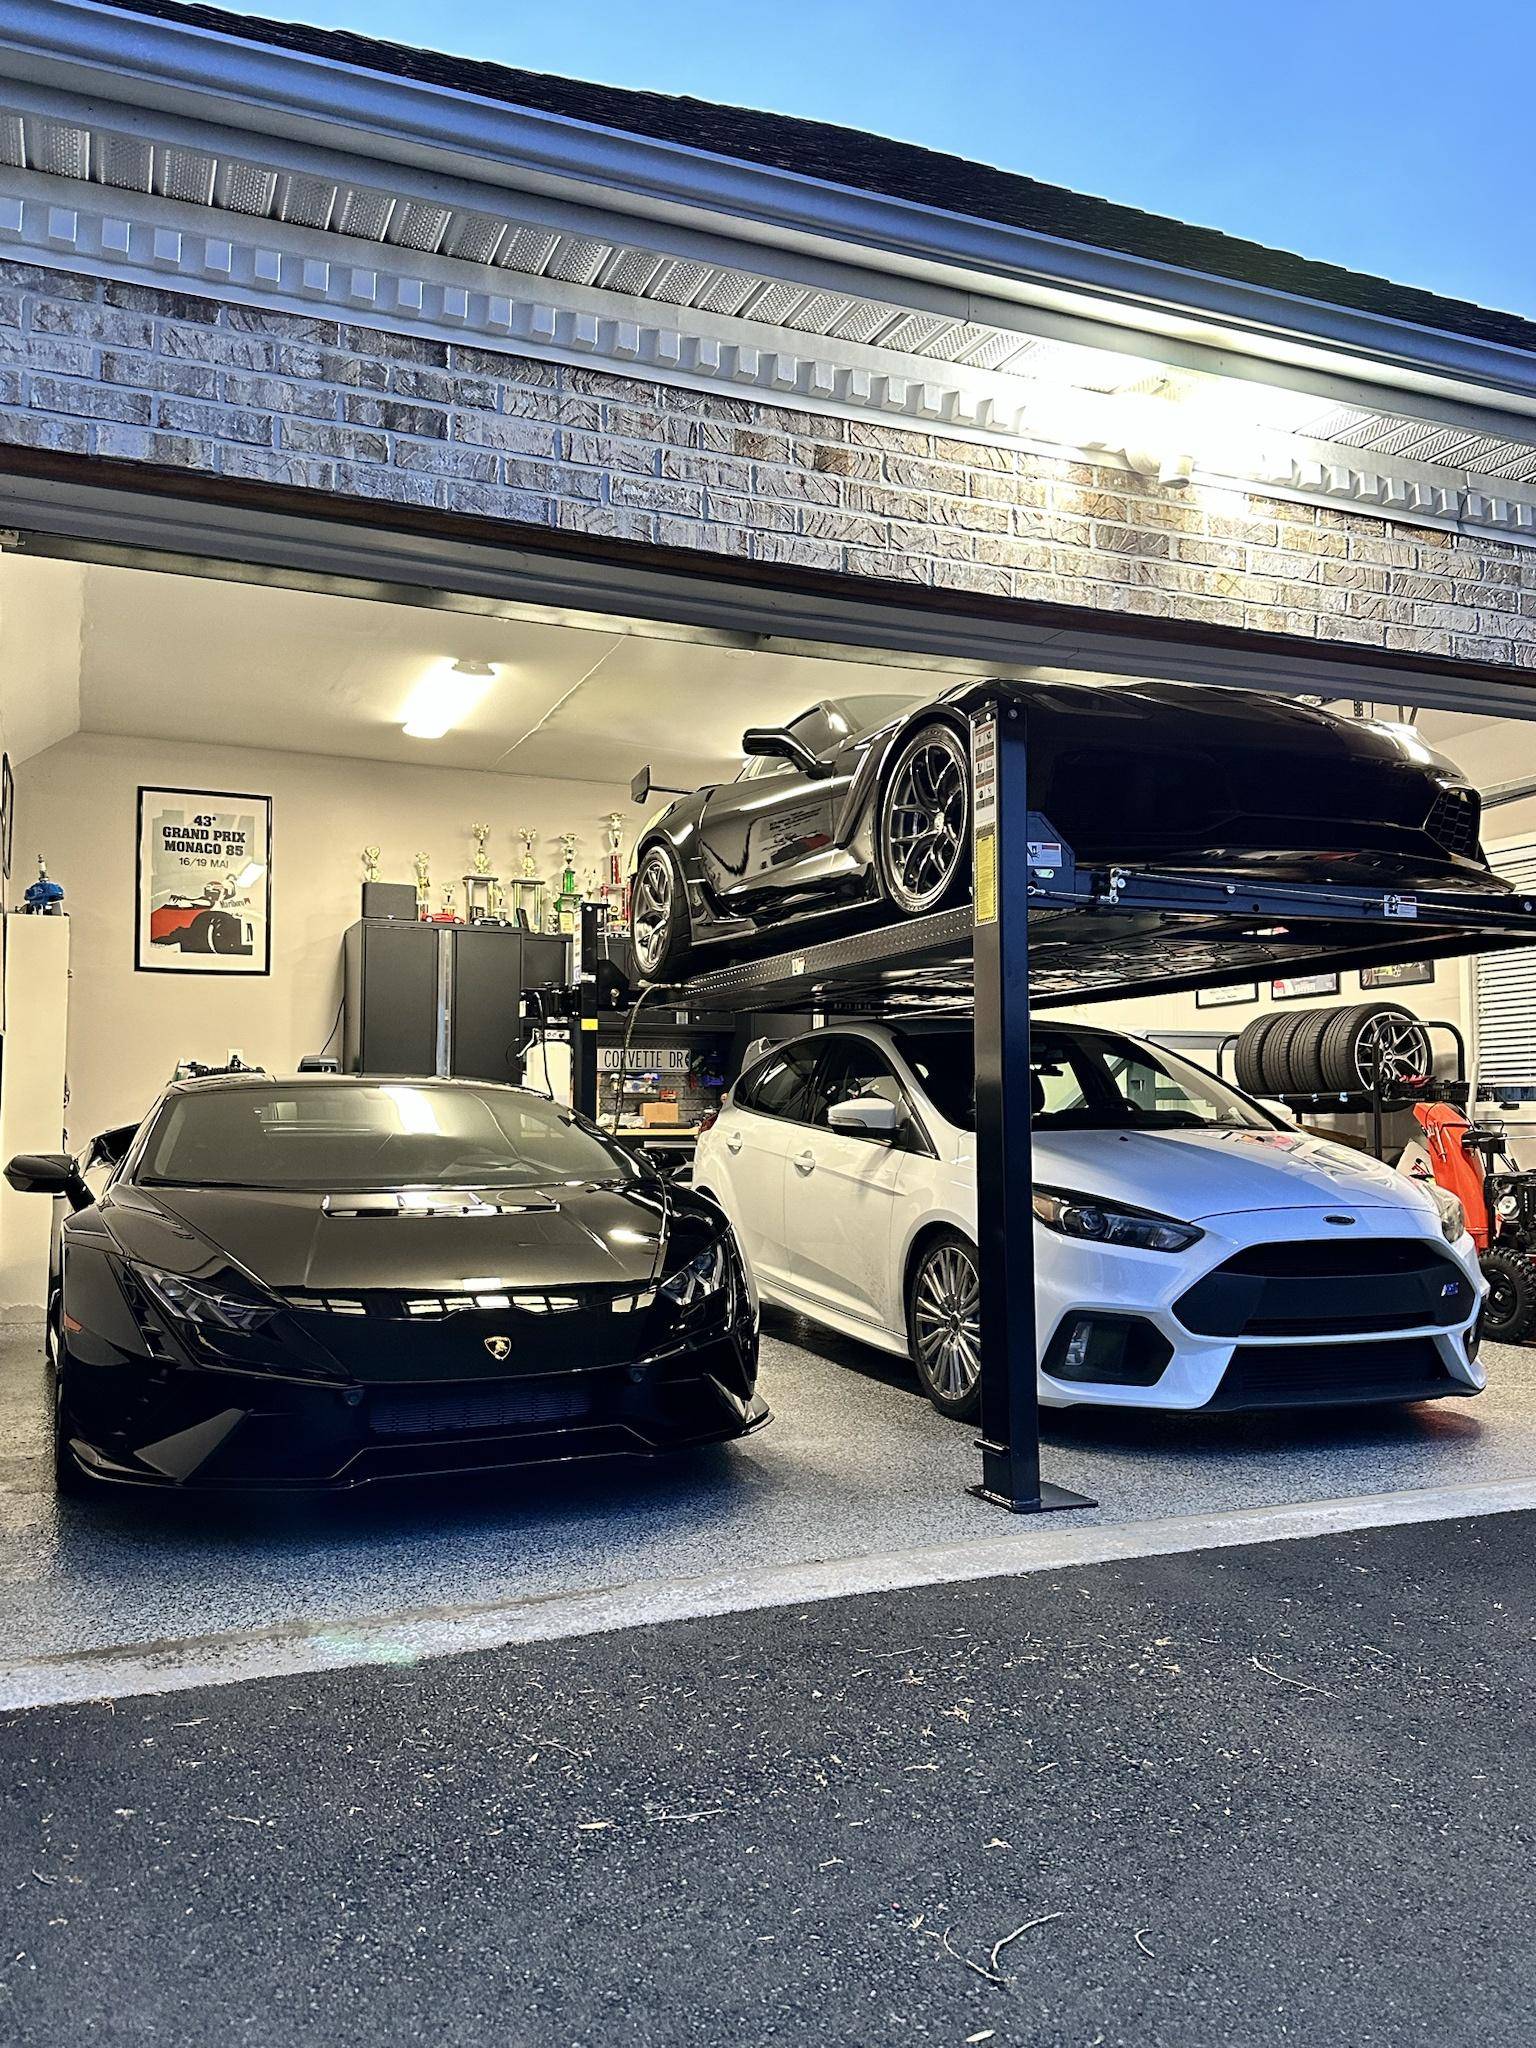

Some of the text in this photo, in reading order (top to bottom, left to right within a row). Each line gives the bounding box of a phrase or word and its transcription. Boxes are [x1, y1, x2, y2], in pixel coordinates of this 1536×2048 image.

[162, 826, 246, 843] GRAND PRIX
[164, 840, 244, 856] MONACO 85
[178, 857, 229, 869] 16/19 MAI
[669, 1051, 684, 1068] DR
